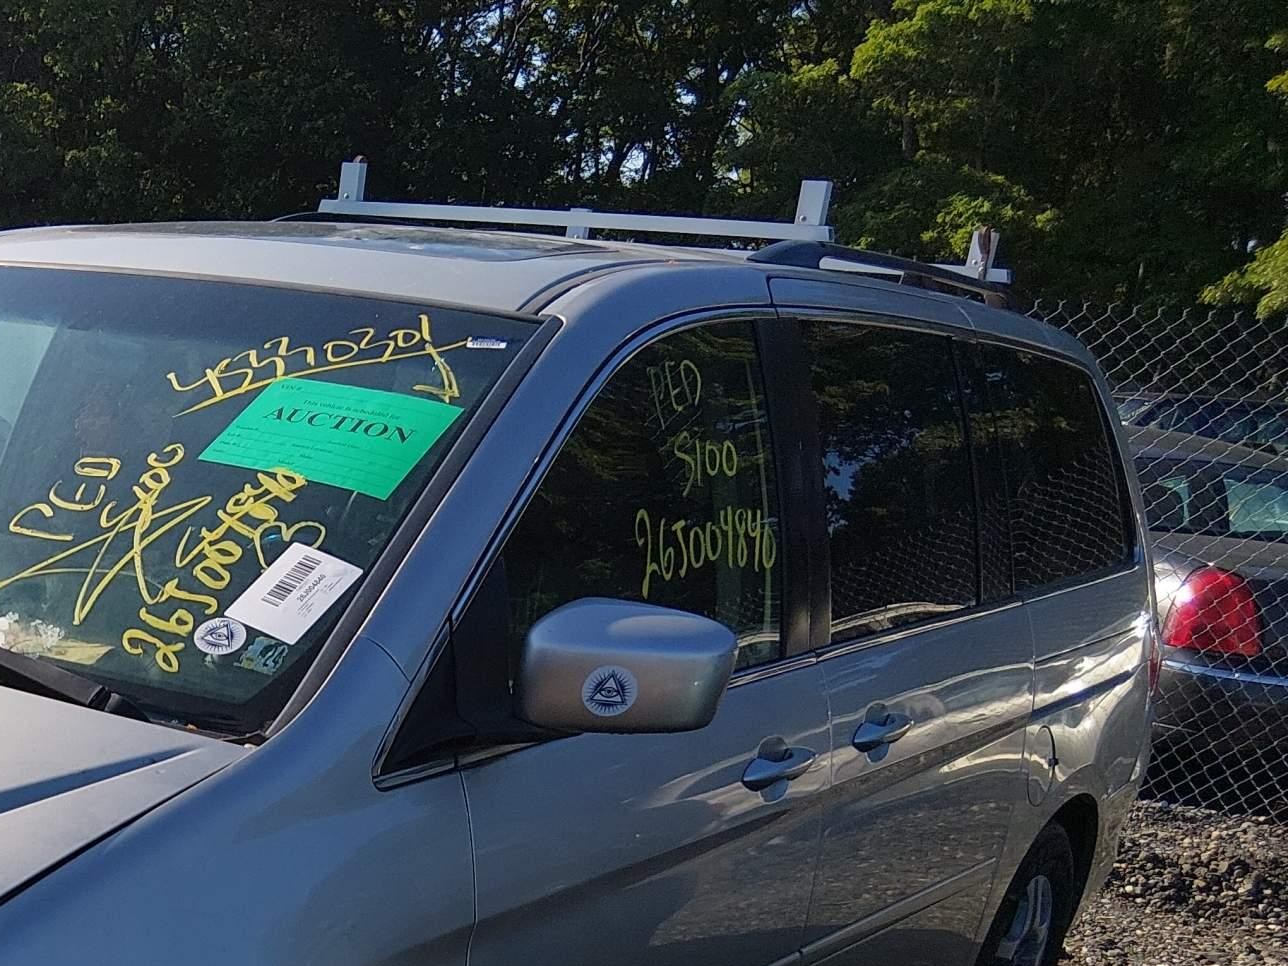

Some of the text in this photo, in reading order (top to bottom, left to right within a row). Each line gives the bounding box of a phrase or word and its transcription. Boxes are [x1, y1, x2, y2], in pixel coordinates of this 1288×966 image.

[166, 314, 432, 398] 45330301
[262, 405, 416, 444] AUCTION
[646, 360, 702, 430] PED
[634, 505, 777, 600] 26J004840
